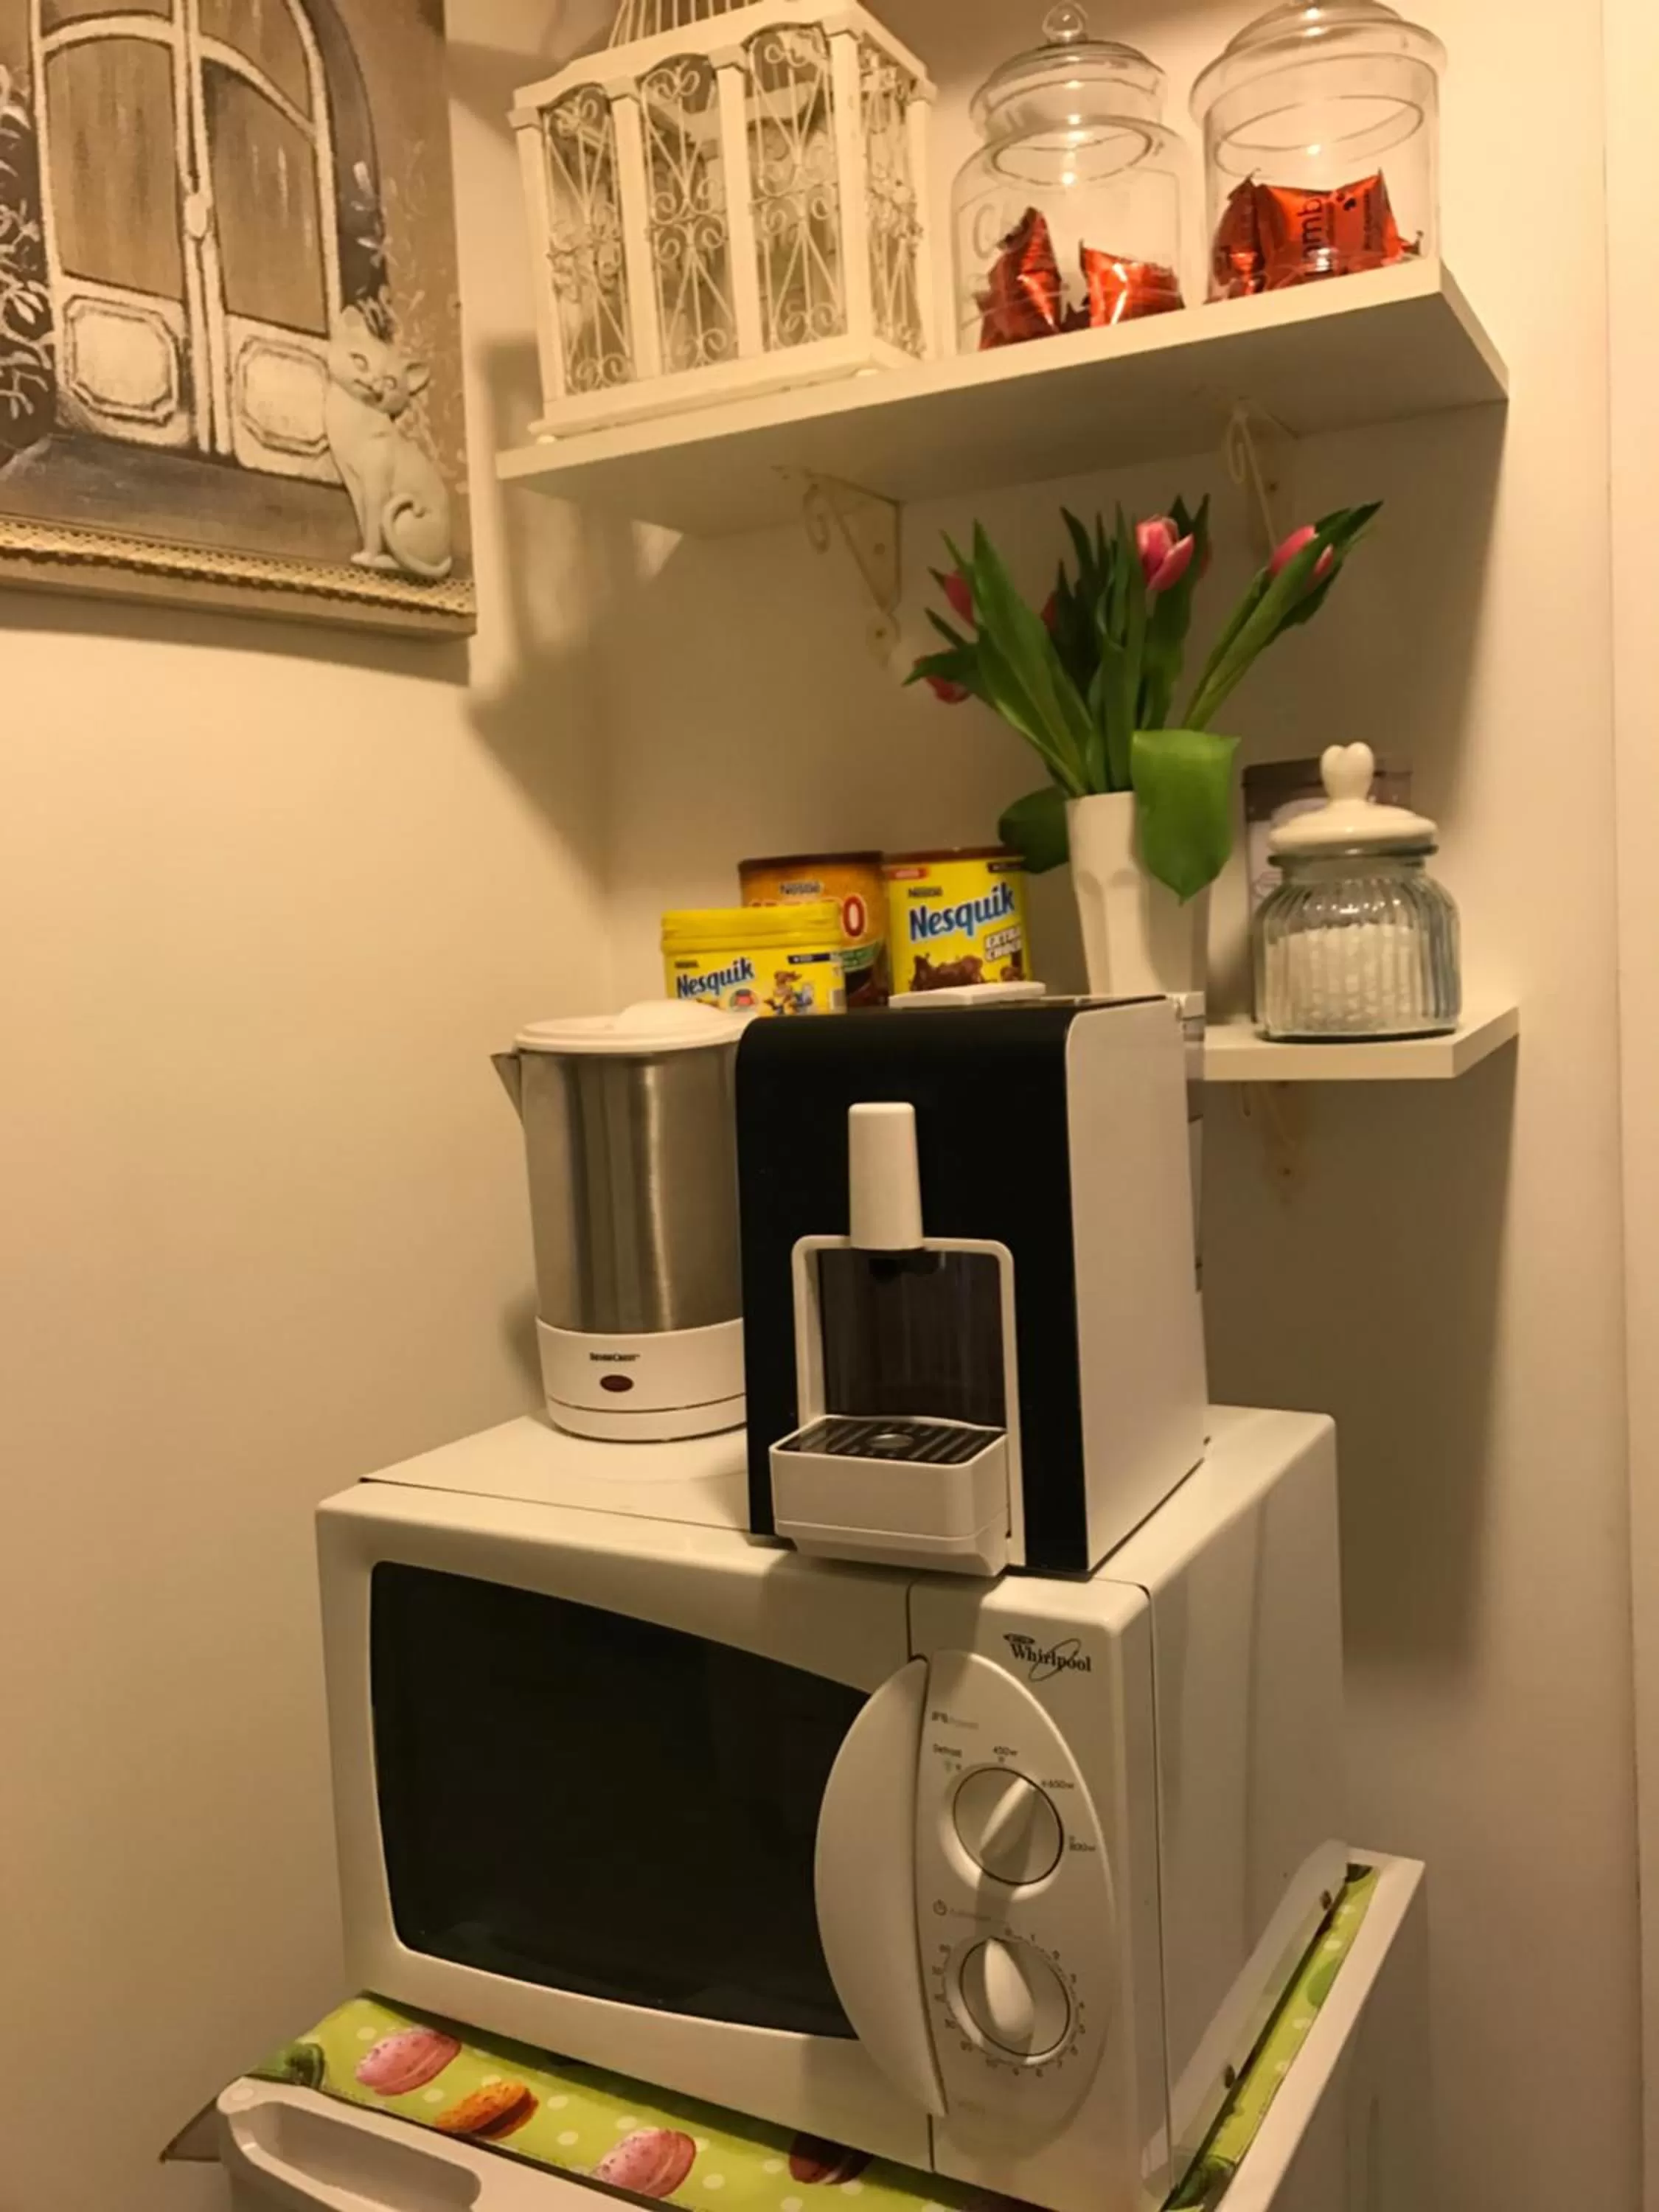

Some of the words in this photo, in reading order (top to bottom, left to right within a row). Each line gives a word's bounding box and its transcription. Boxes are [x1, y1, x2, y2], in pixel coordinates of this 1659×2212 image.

[908, 882, 1015, 942] Nesquik
[677, 957, 755, 999] Nesquik
[1010, 1642, 1091, 1672] Whirlpool
